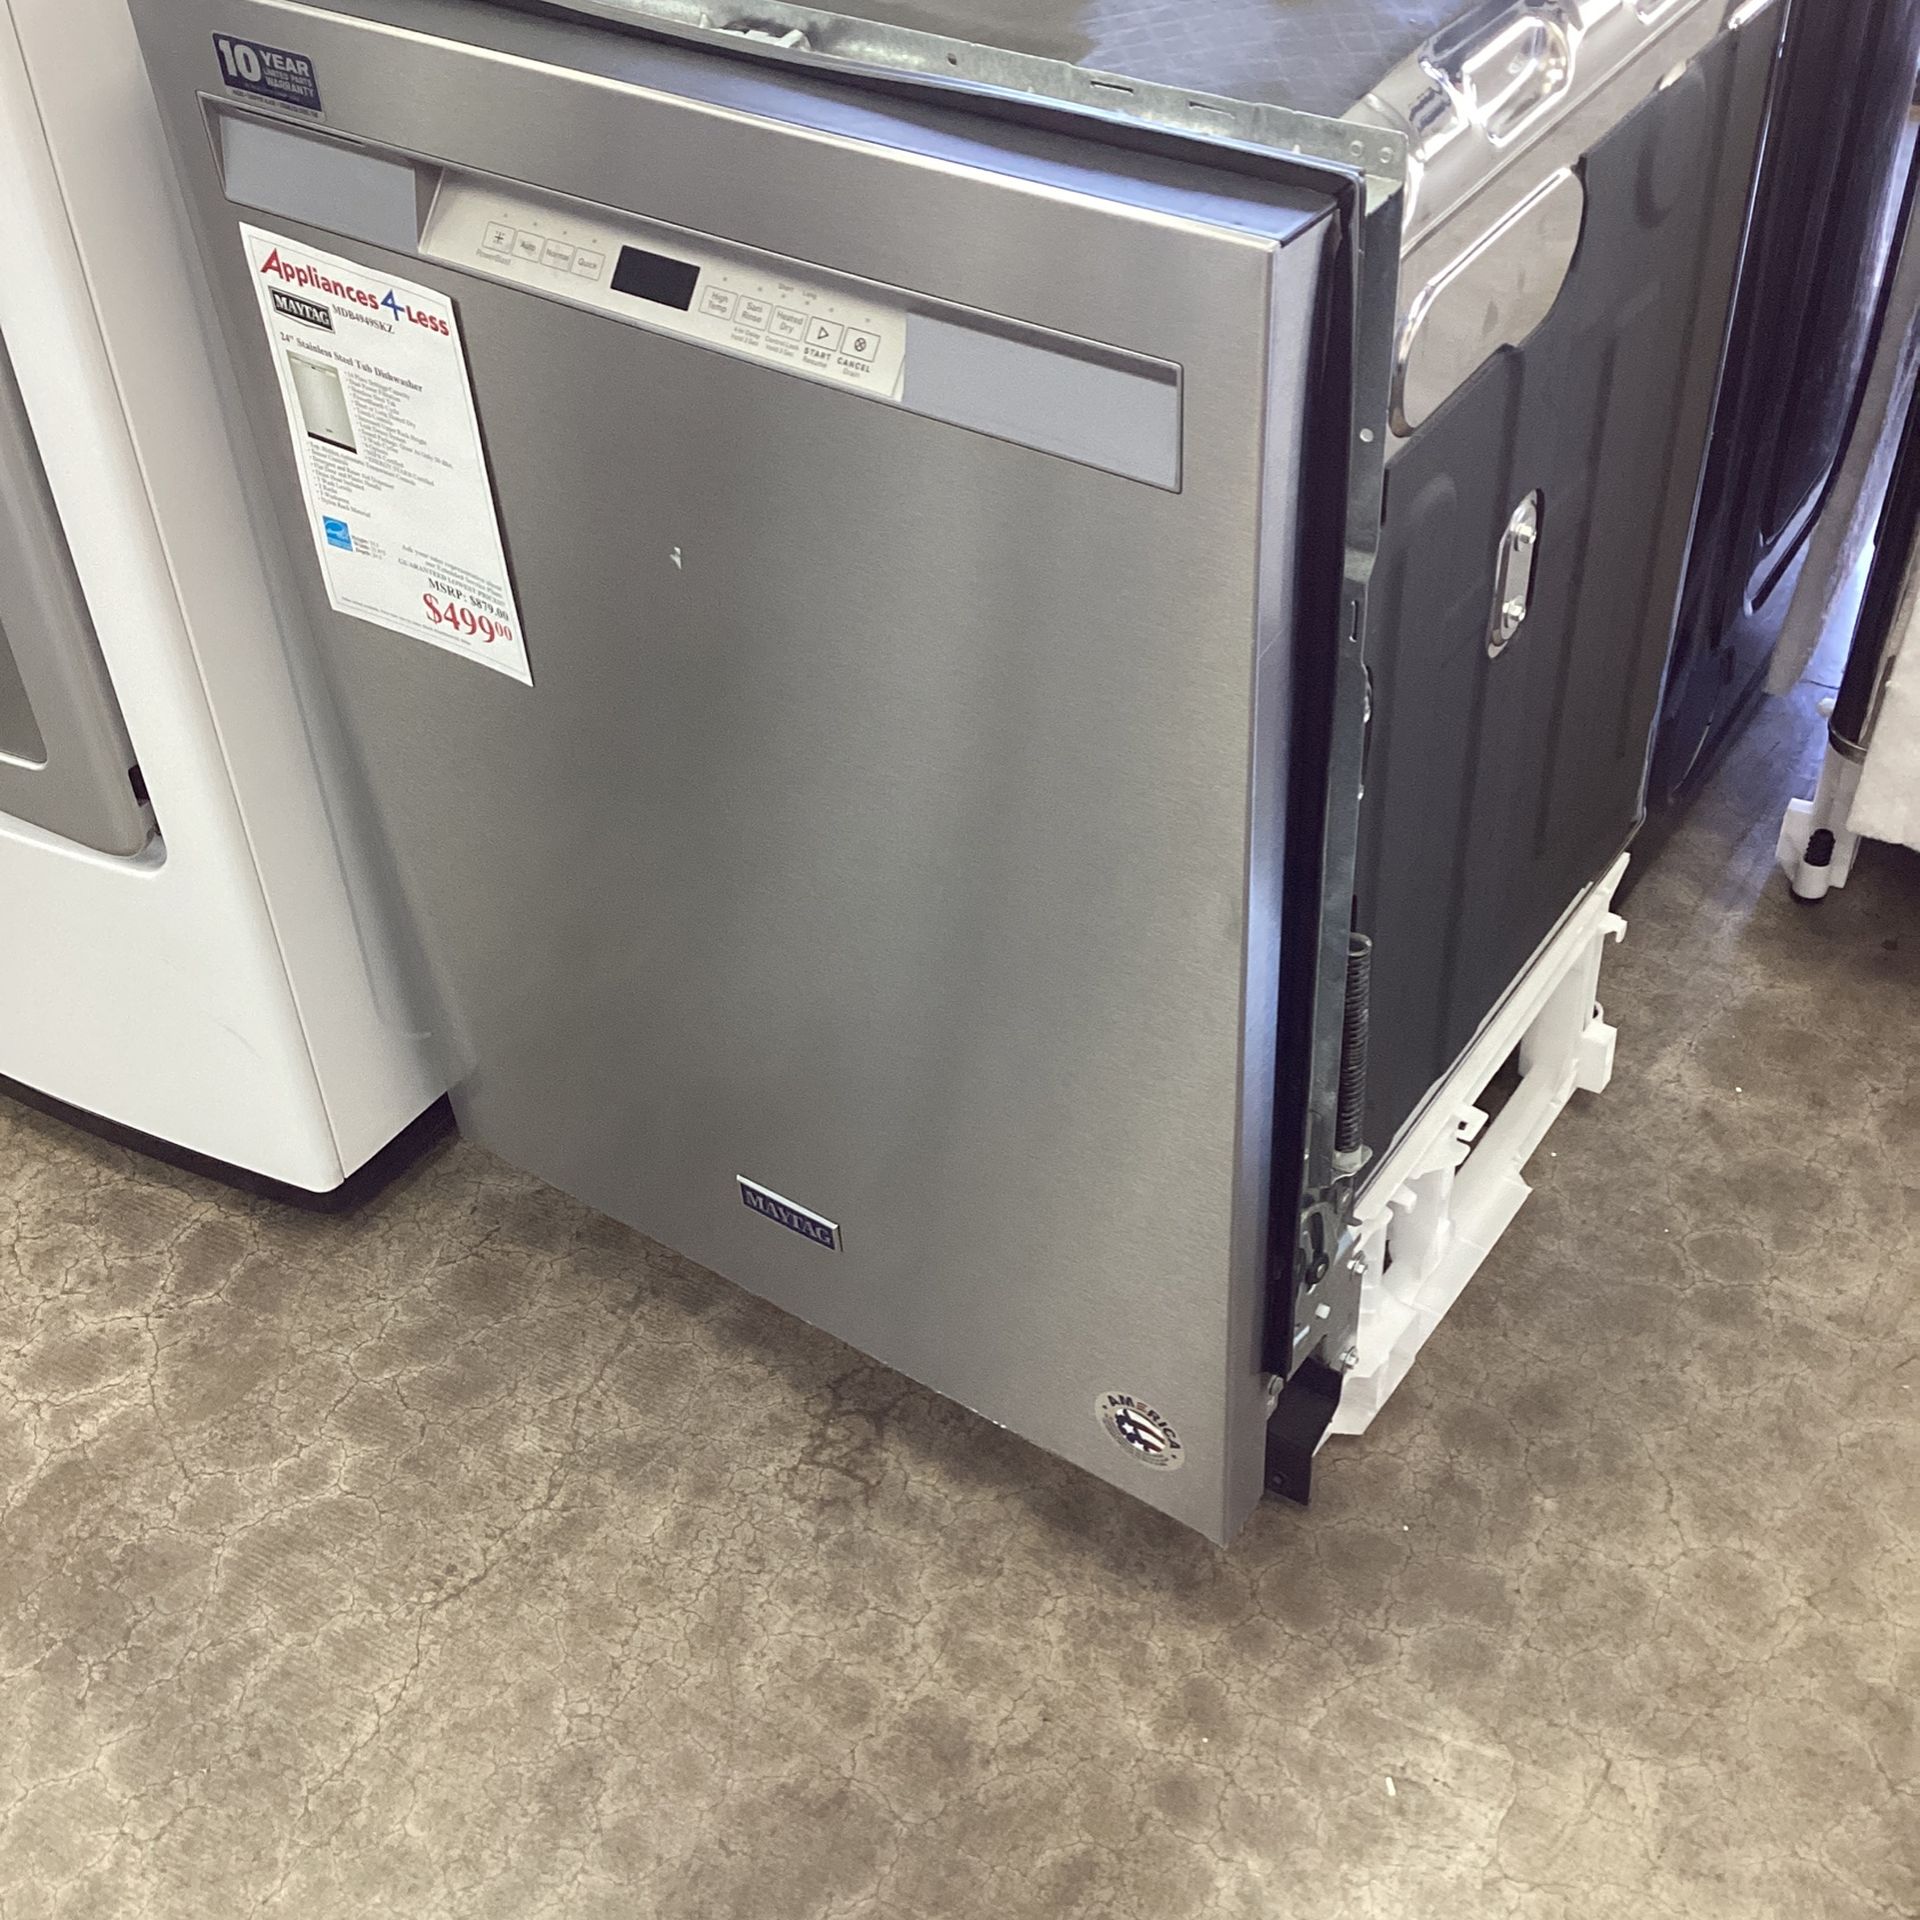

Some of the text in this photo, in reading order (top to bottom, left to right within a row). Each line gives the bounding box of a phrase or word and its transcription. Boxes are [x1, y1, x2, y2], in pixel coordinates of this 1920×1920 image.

[218, 39, 310, 82] 10 YEAR
[265, 76, 315, 97] WARRANTY
[577, 257, 597, 269] Quick
[260, 248, 449, 336] Appliances 4 Less
[274, 293, 330, 326] MAYTAG
[780, 322, 794, 334] Dry
[297, 338, 332, 358] Stainless
[334, 352, 353, 366] Steel
[356, 360, 373, 374] Tub
[375, 367, 422, 392] Dishwasher
[804, 347, 832, 361] START
[837, 357, 871, 373] CANCEL
[428, 578, 468, 602] MSRP:
[470, 595, 509, 621] $879.00
[745, 1190, 832, 1243] MAYTAG
[1107, 1395, 1181, 1449] AMERICA
